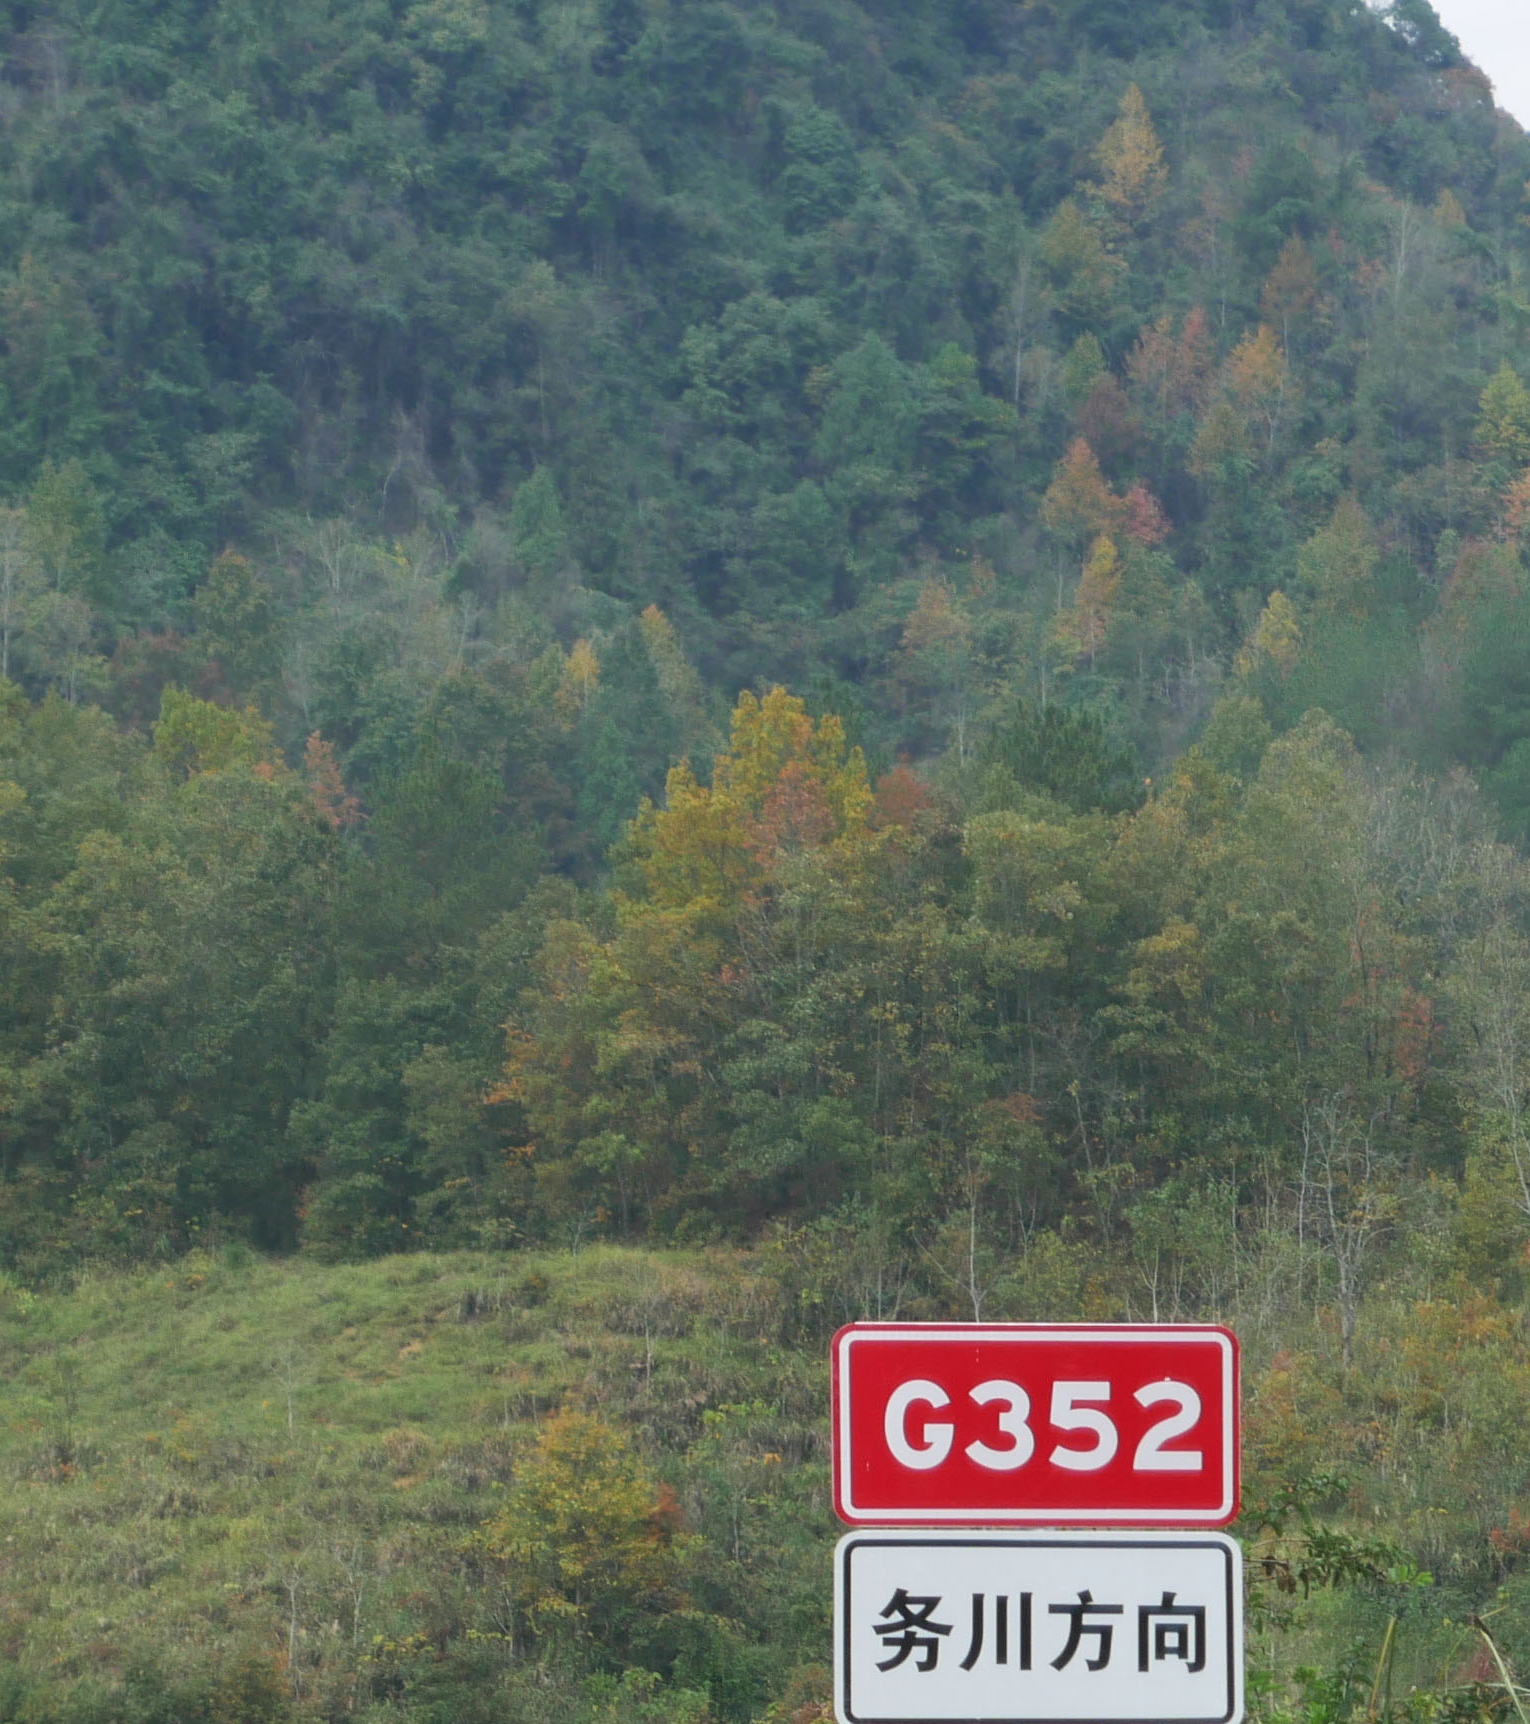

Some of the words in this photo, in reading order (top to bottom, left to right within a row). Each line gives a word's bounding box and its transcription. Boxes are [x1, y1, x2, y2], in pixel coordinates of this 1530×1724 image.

[884, 1379, 1203, 1471] G352
[872, 1588, 1207, 1673] 务川方向
